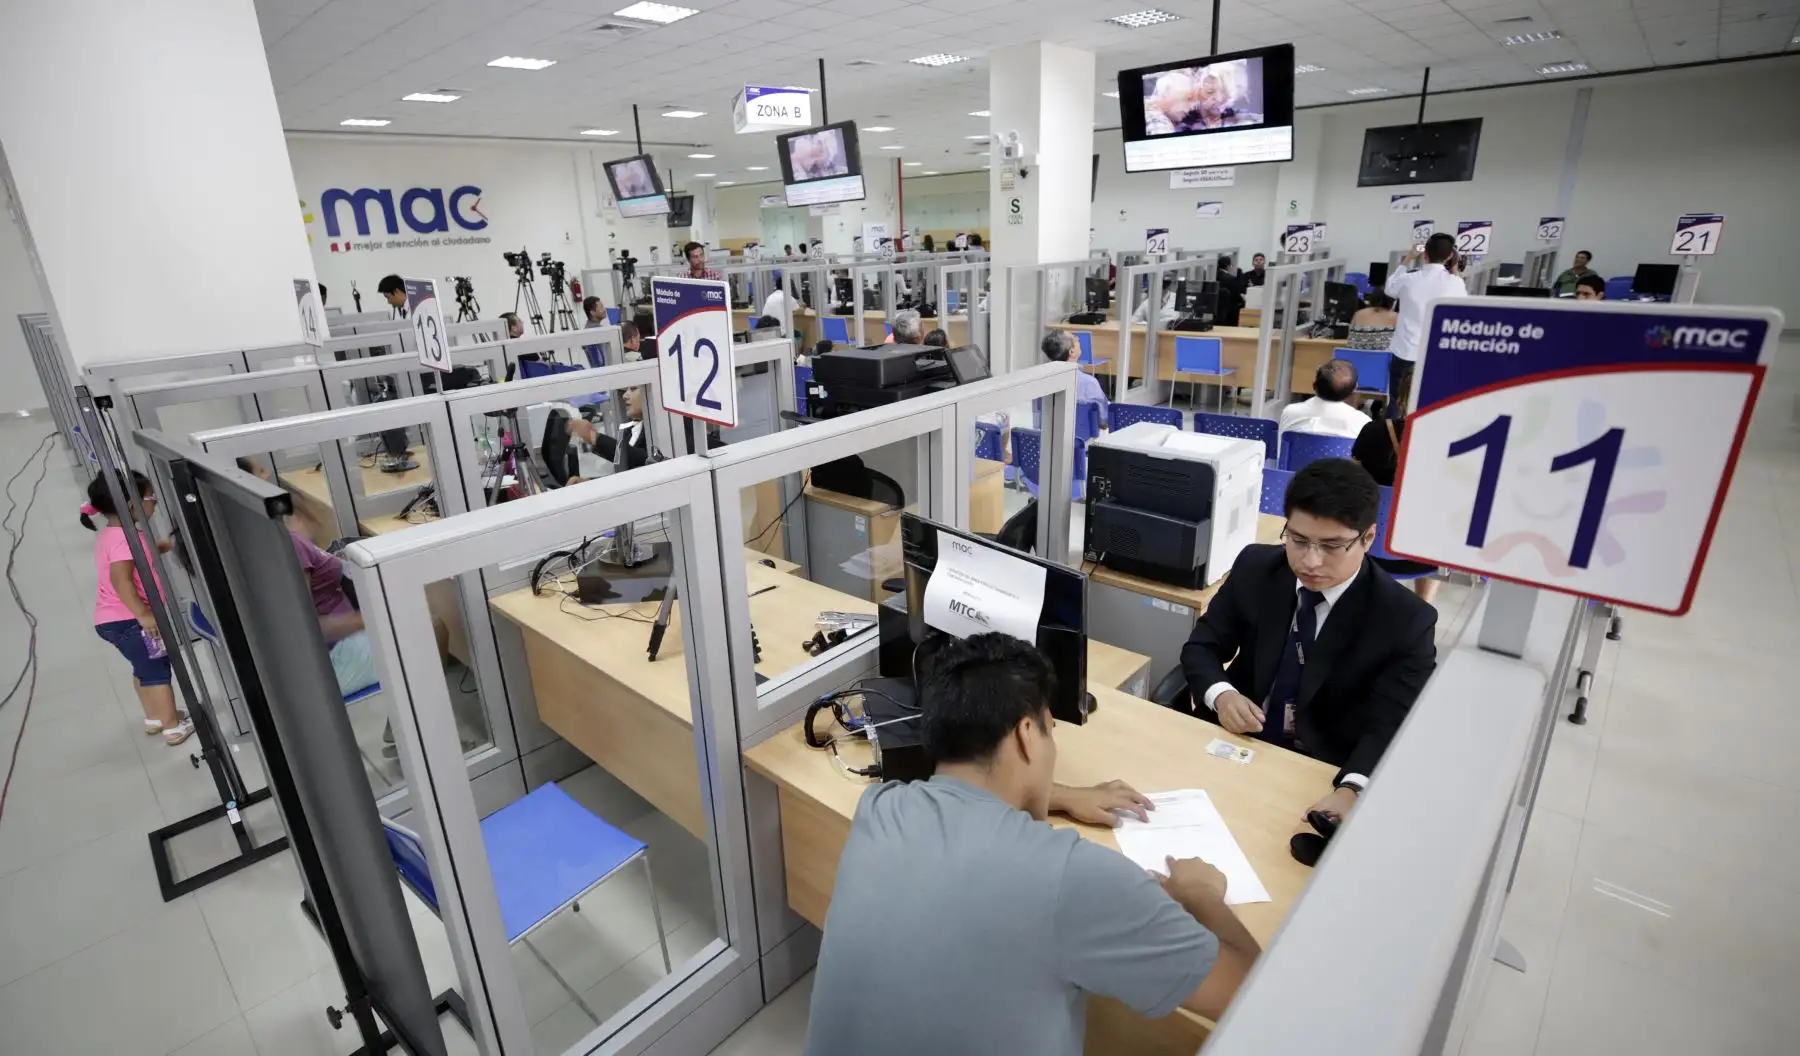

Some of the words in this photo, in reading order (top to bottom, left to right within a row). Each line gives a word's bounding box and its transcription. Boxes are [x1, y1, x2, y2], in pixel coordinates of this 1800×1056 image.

[757, 104, 788, 117] ZONA
[794, 106, 801, 118] B
[321, 185, 489, 237] mac
[1011, 198, 1020, 214] S
[1290, 200, 1298, 210] S
[1415, 227, 1430, 240] 33
[1540, 225, 1560, 239] 32
[1675, 231, 1710, 251] 21
[353, 241, 382, 251] mejor
[386, 238, 429, 249] atención
[432, 238, 440, 246] al
[442, 236, 491, 246] ciudadano
[882, 244, 893, 257] 25
[1149, 238, 1166, 254] 24
[1287, 235, 1309, 253] 23
[1458, 233, 1486, 252] 22
[707, 290, 723, 299] mac
[417, 313, 442, 362] 13
[1441, 318, 1514, 337] Módulo
[1518, 323, 1544, 339] de
[1672, 326, 1749, 348] mac
[1438, 336, 1520, 354] atención
[668, 334, 722, 410] 12
[1447, 414, 1626, 569] 11
[951, 541, 973, 555] mac
[949, 598, 975, 619] MTC
